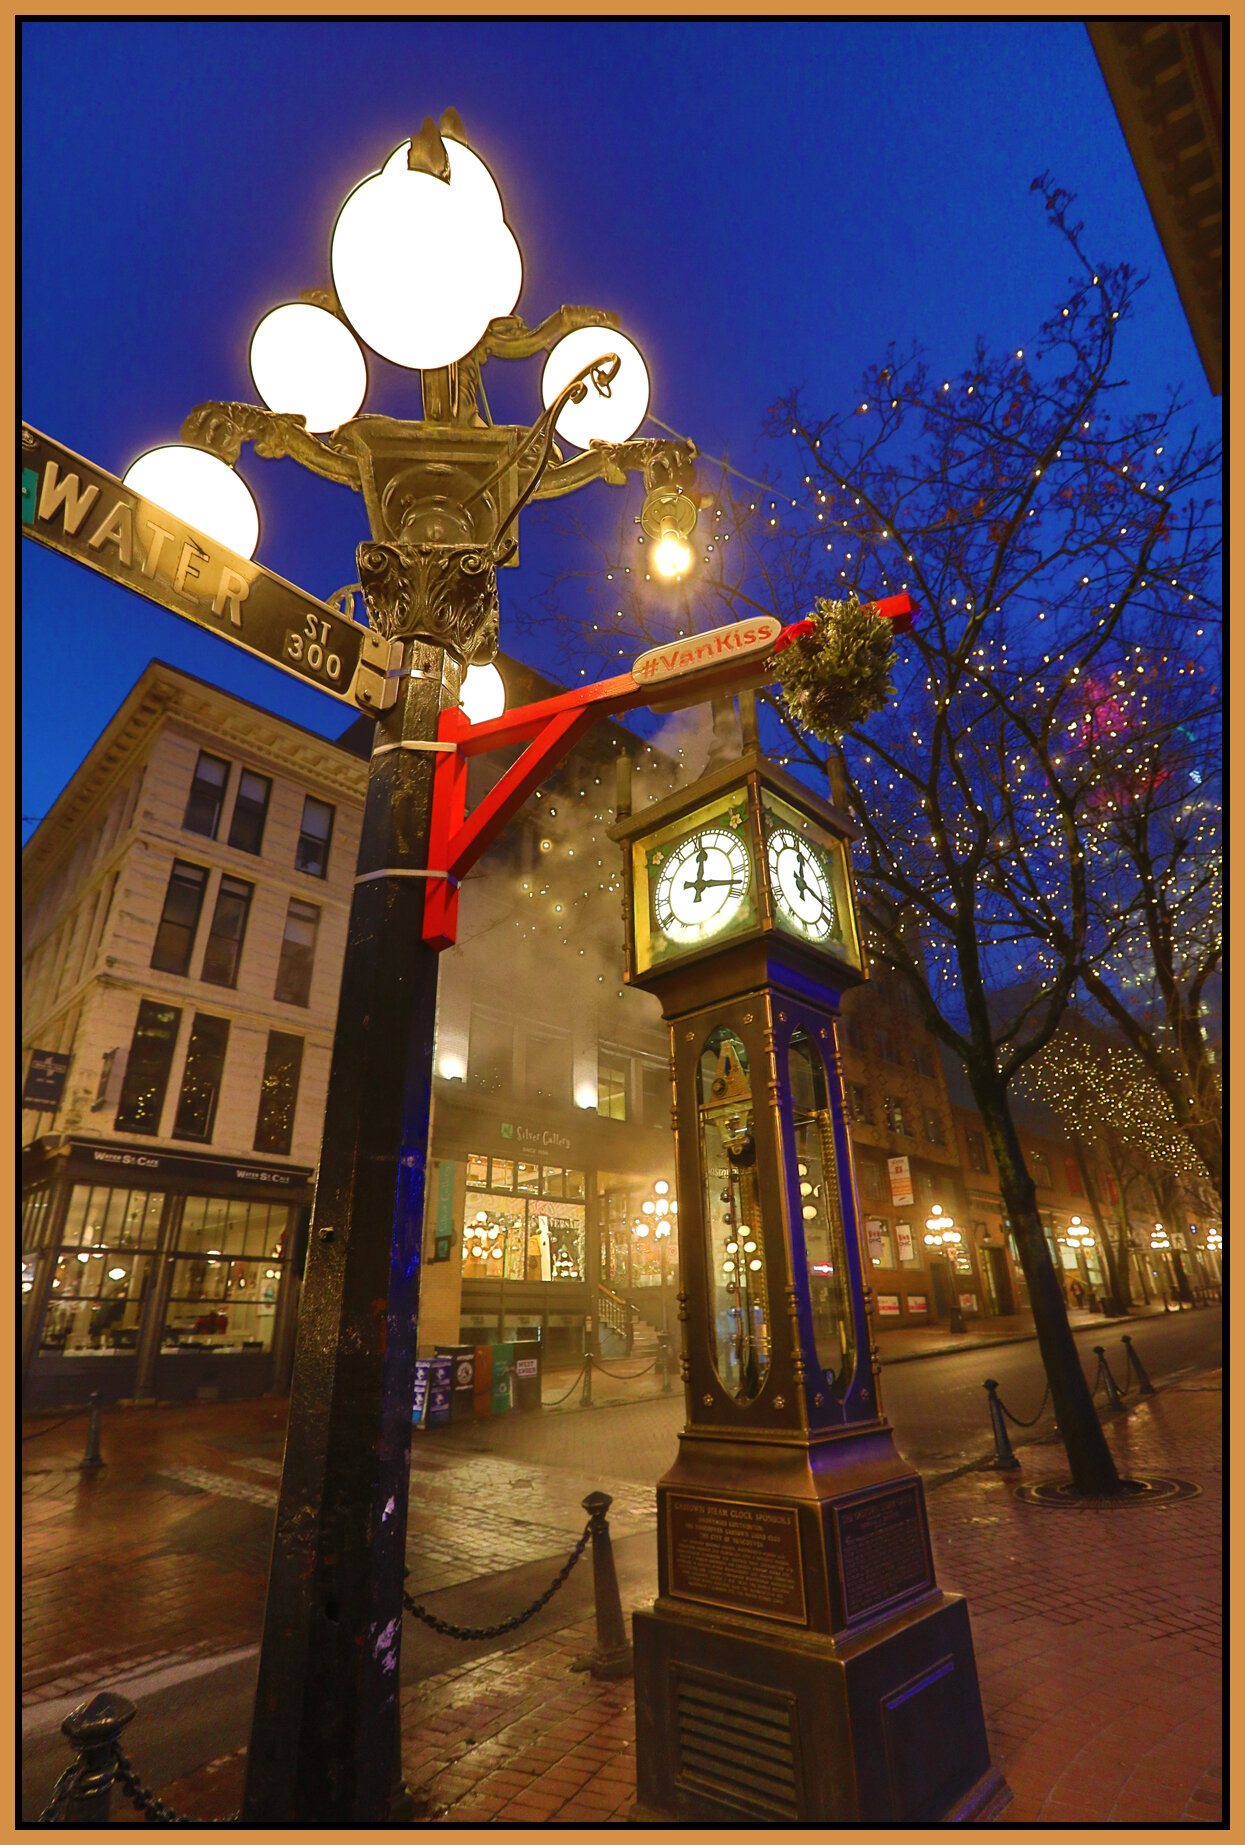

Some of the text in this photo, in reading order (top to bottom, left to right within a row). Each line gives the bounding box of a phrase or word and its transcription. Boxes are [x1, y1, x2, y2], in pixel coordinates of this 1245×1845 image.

[38, 460, 251, 628] WATER
[304, 613, 333, 647] ST
[287, 633, 342, 681] 300
[641, 624, 772, 678] #VanKiss
[516, 1125, 571, 1149] Silver Gallery
[730, 1509, 753, 1521] CLOCK
